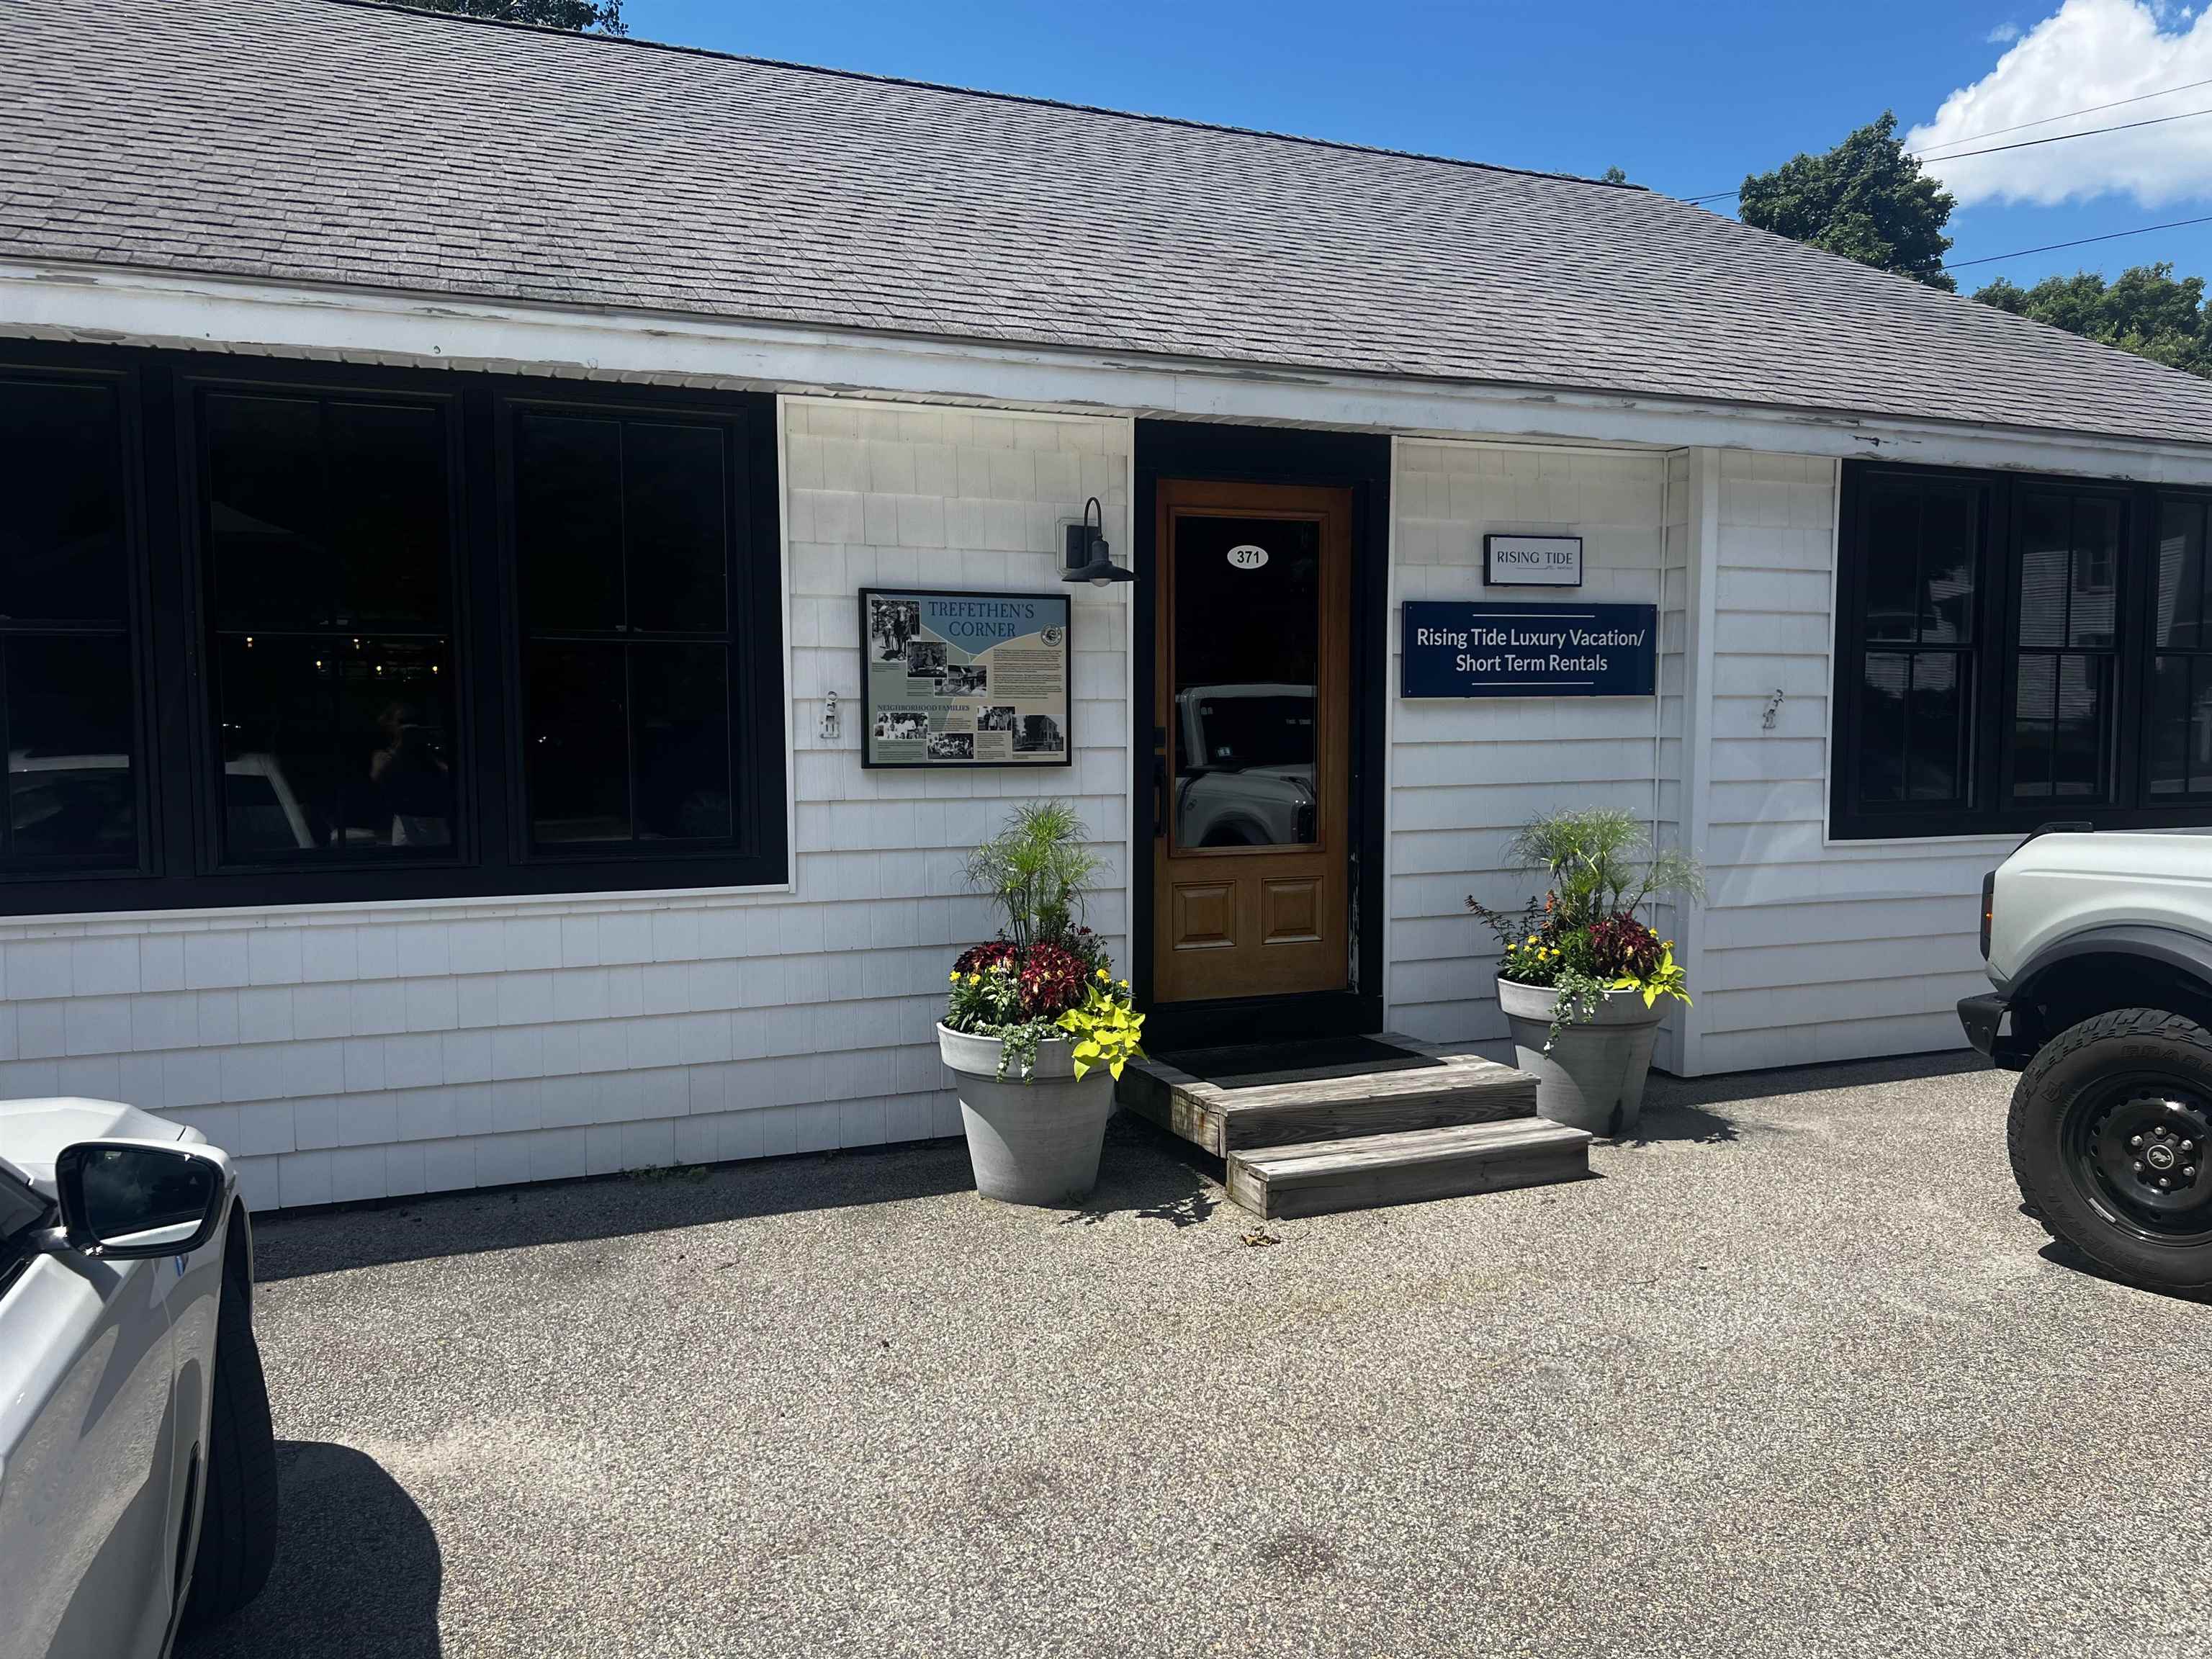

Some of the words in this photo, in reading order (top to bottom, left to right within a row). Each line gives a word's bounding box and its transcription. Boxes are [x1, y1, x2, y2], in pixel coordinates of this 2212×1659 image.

[1237, 550, 1259, 564] 371
[1497, 551, 1539, 564] RISING
[1545, 552, 1573, 565] TIDE
[928, 601, 1035, 619] TREFETHEN'S
[949, 621, 1016, 637] CORNER
[1417, 628, 1468, 649] Rising
[1471, 629, 1507, 646] Tide
[1511, 629, 1566, 649] Luxury
[1570, 629, 1645, 647] Vacation/
[1456, 655, 1501, 671] Short
[1505, 655, 1545, 671] Term
[1549, 655, 1608, 671] Rentals
